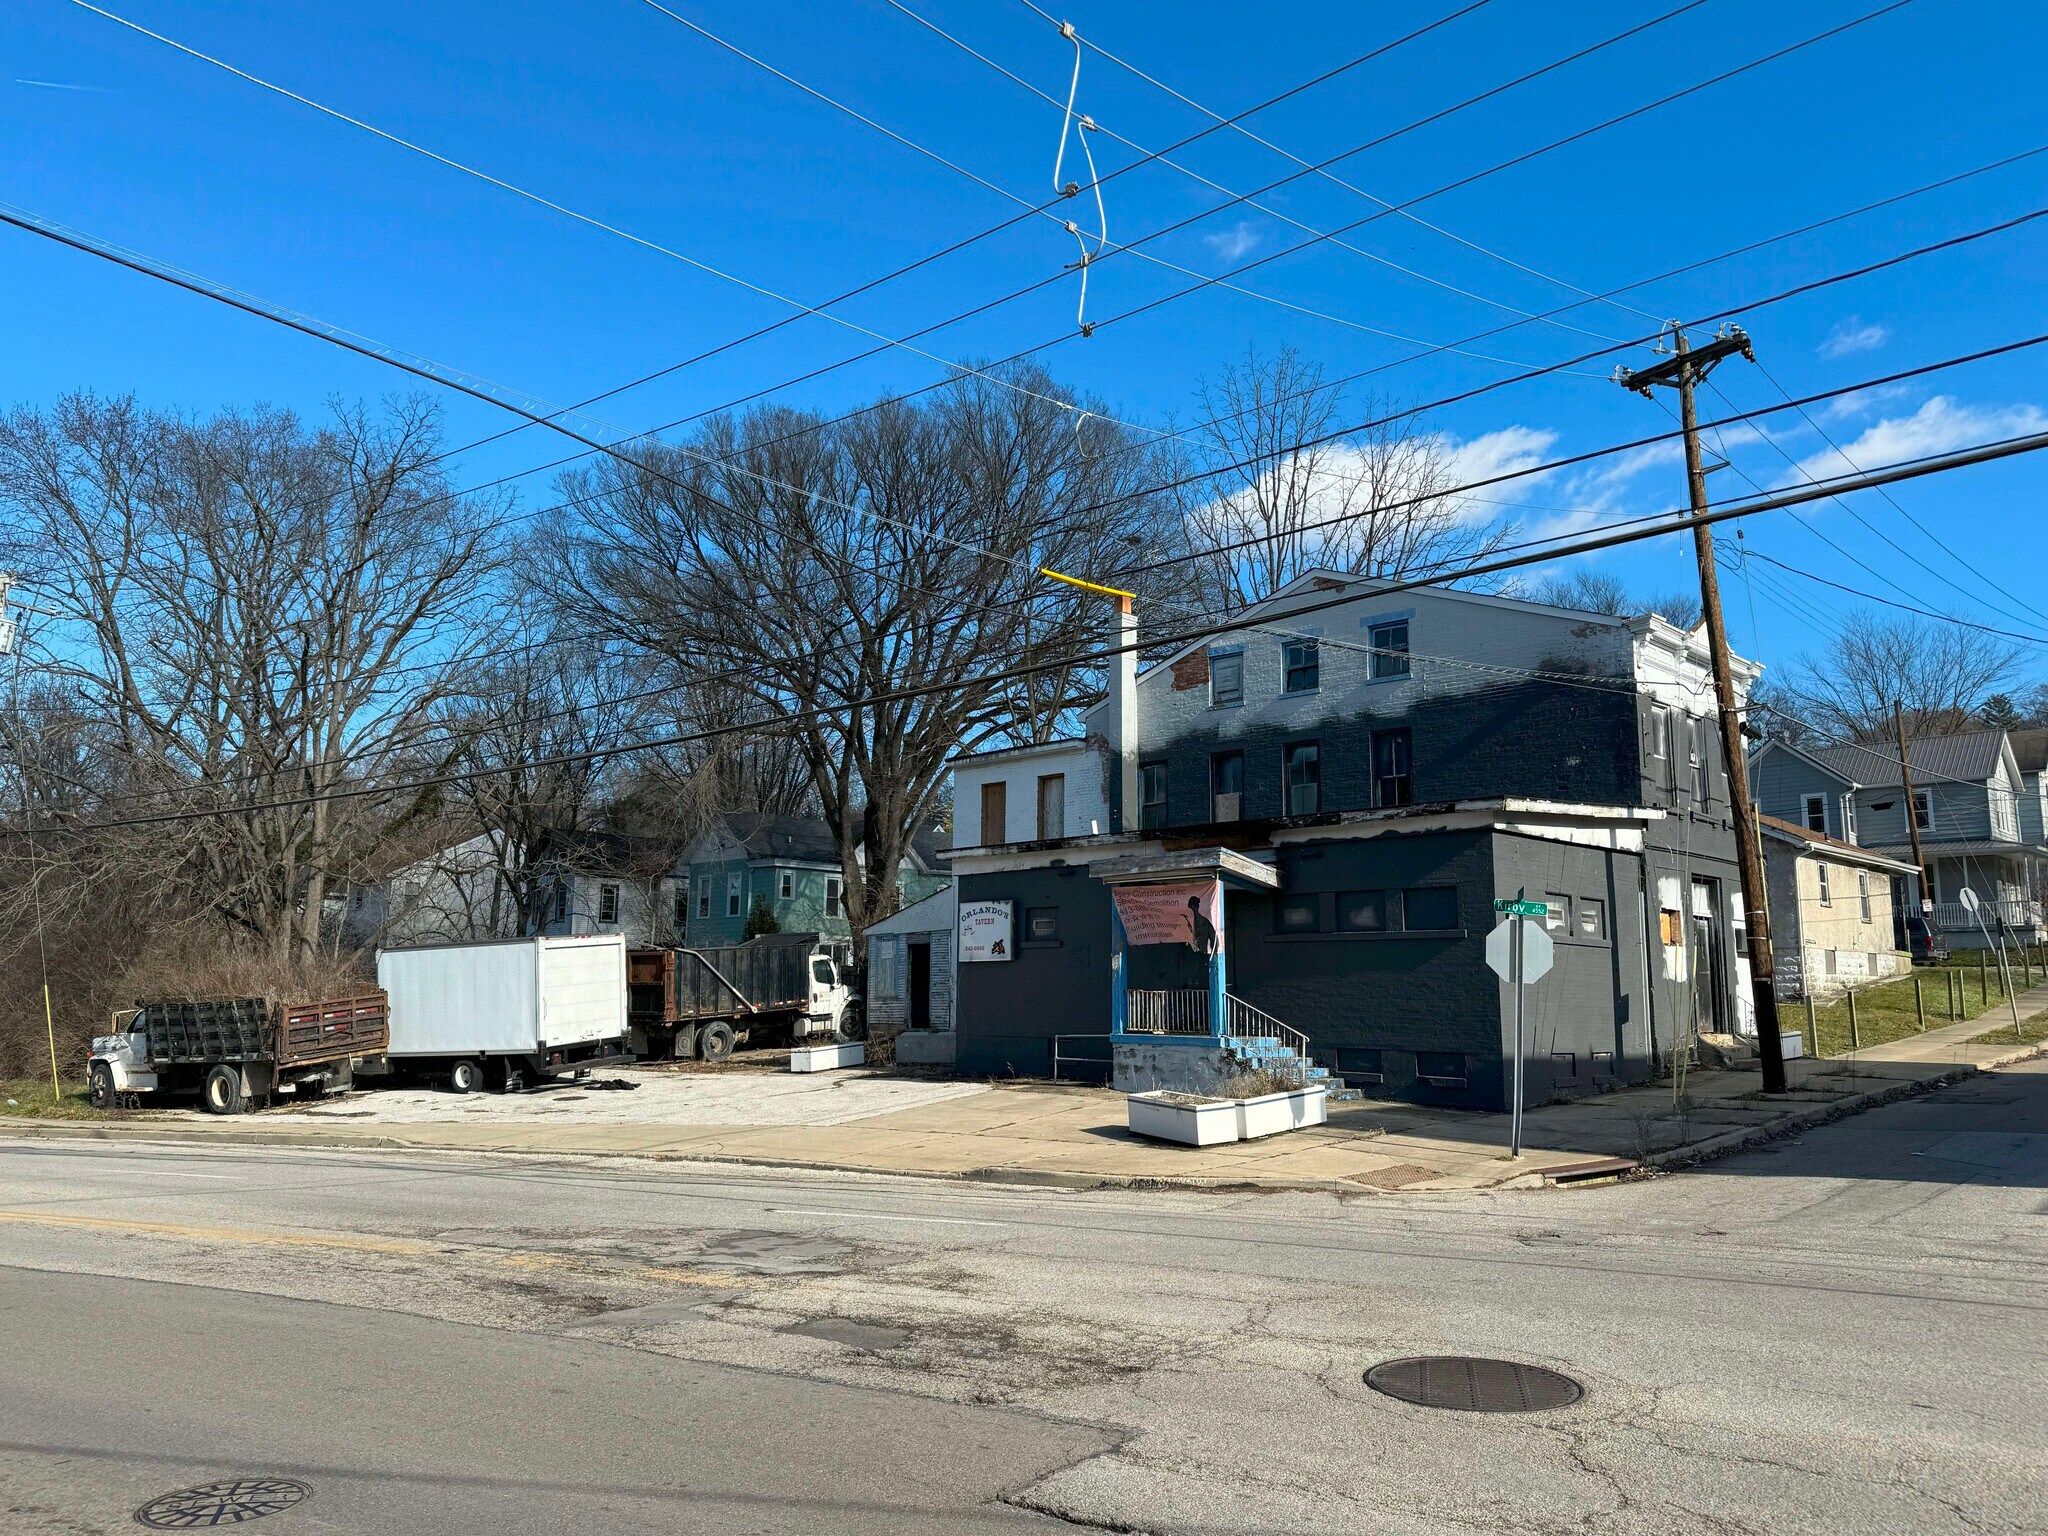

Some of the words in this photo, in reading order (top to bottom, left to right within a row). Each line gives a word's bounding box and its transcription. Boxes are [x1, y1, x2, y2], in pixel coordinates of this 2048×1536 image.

[1132, 889, 1175, 898] Construction
[1144, 899, 1179, 907] Demolition
[1497, 900, 1525, 913] Kirby
[961, 906, 1009, 922] ORLANDO'S
[975, 918, 995, 926] TAVERN
[1125, 923, 1156, 933] Building
[166, 1493, 288, 1511] SEWER
